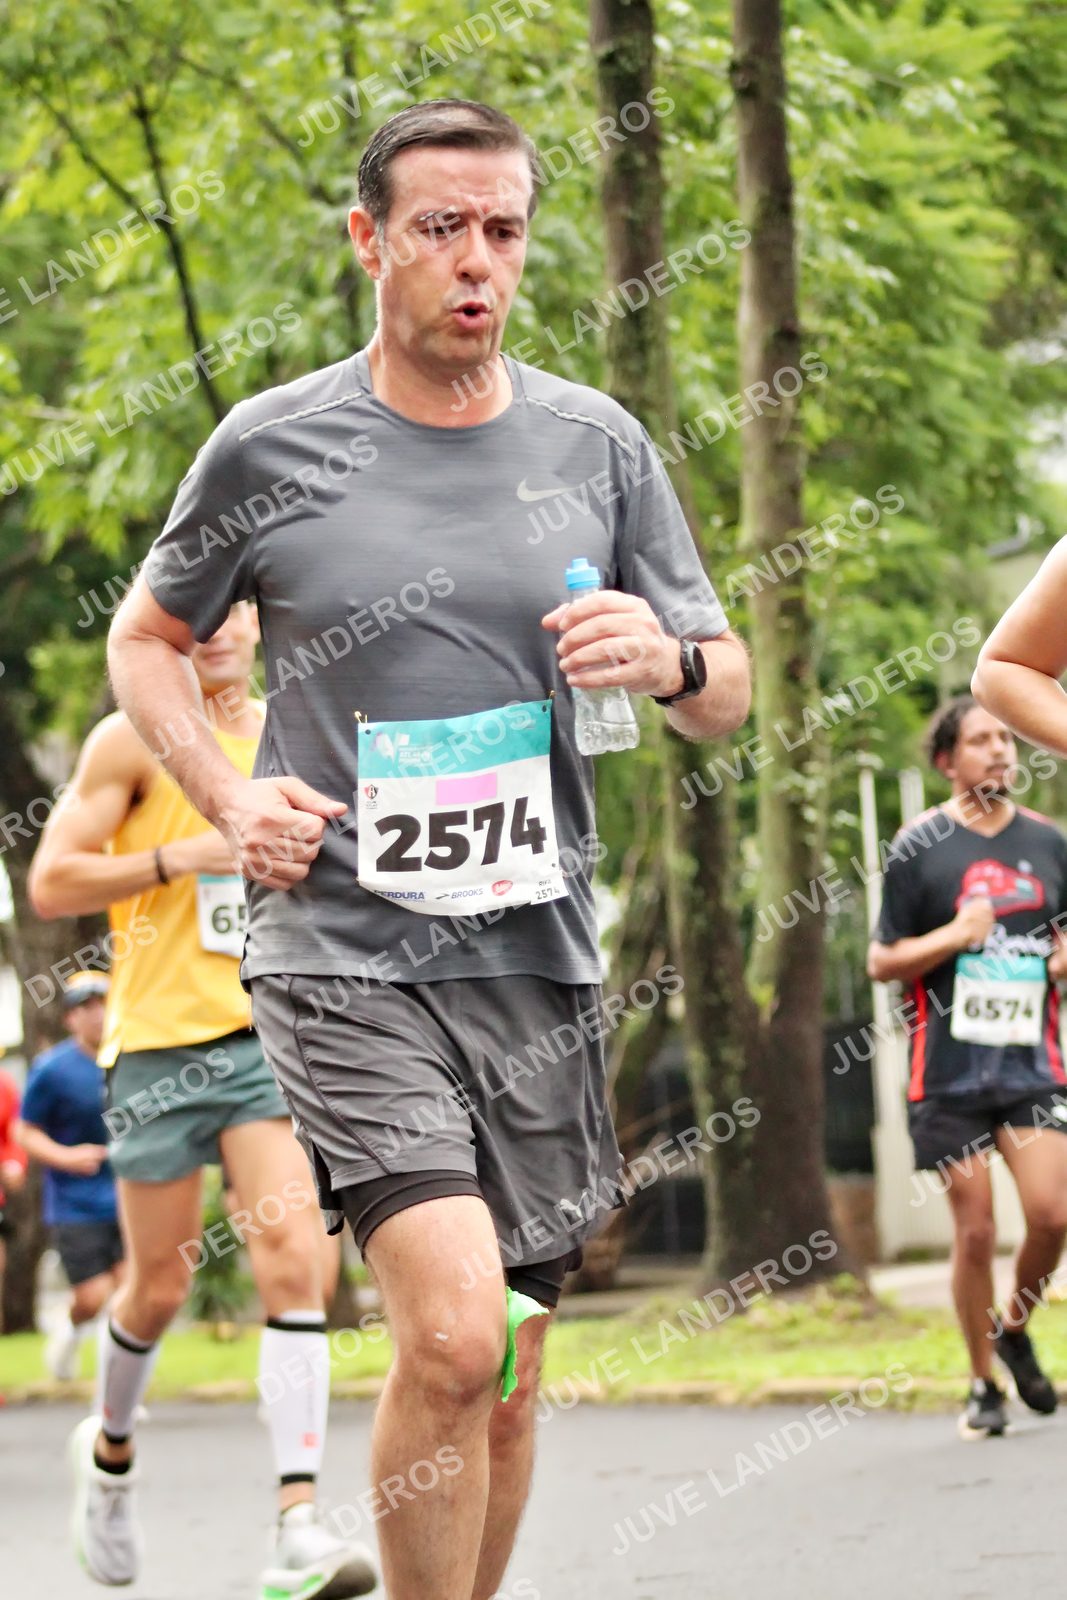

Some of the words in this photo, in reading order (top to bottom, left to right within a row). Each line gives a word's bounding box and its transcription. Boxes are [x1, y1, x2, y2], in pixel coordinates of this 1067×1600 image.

[374, 796, 547, 872] 2574
[374, 890, 425, 900] ERDURA
[451, 888, 484, 899] BROOKS
[535, 887, 560, 900] 2574
[964, 997, 1033, 1020] 6574
